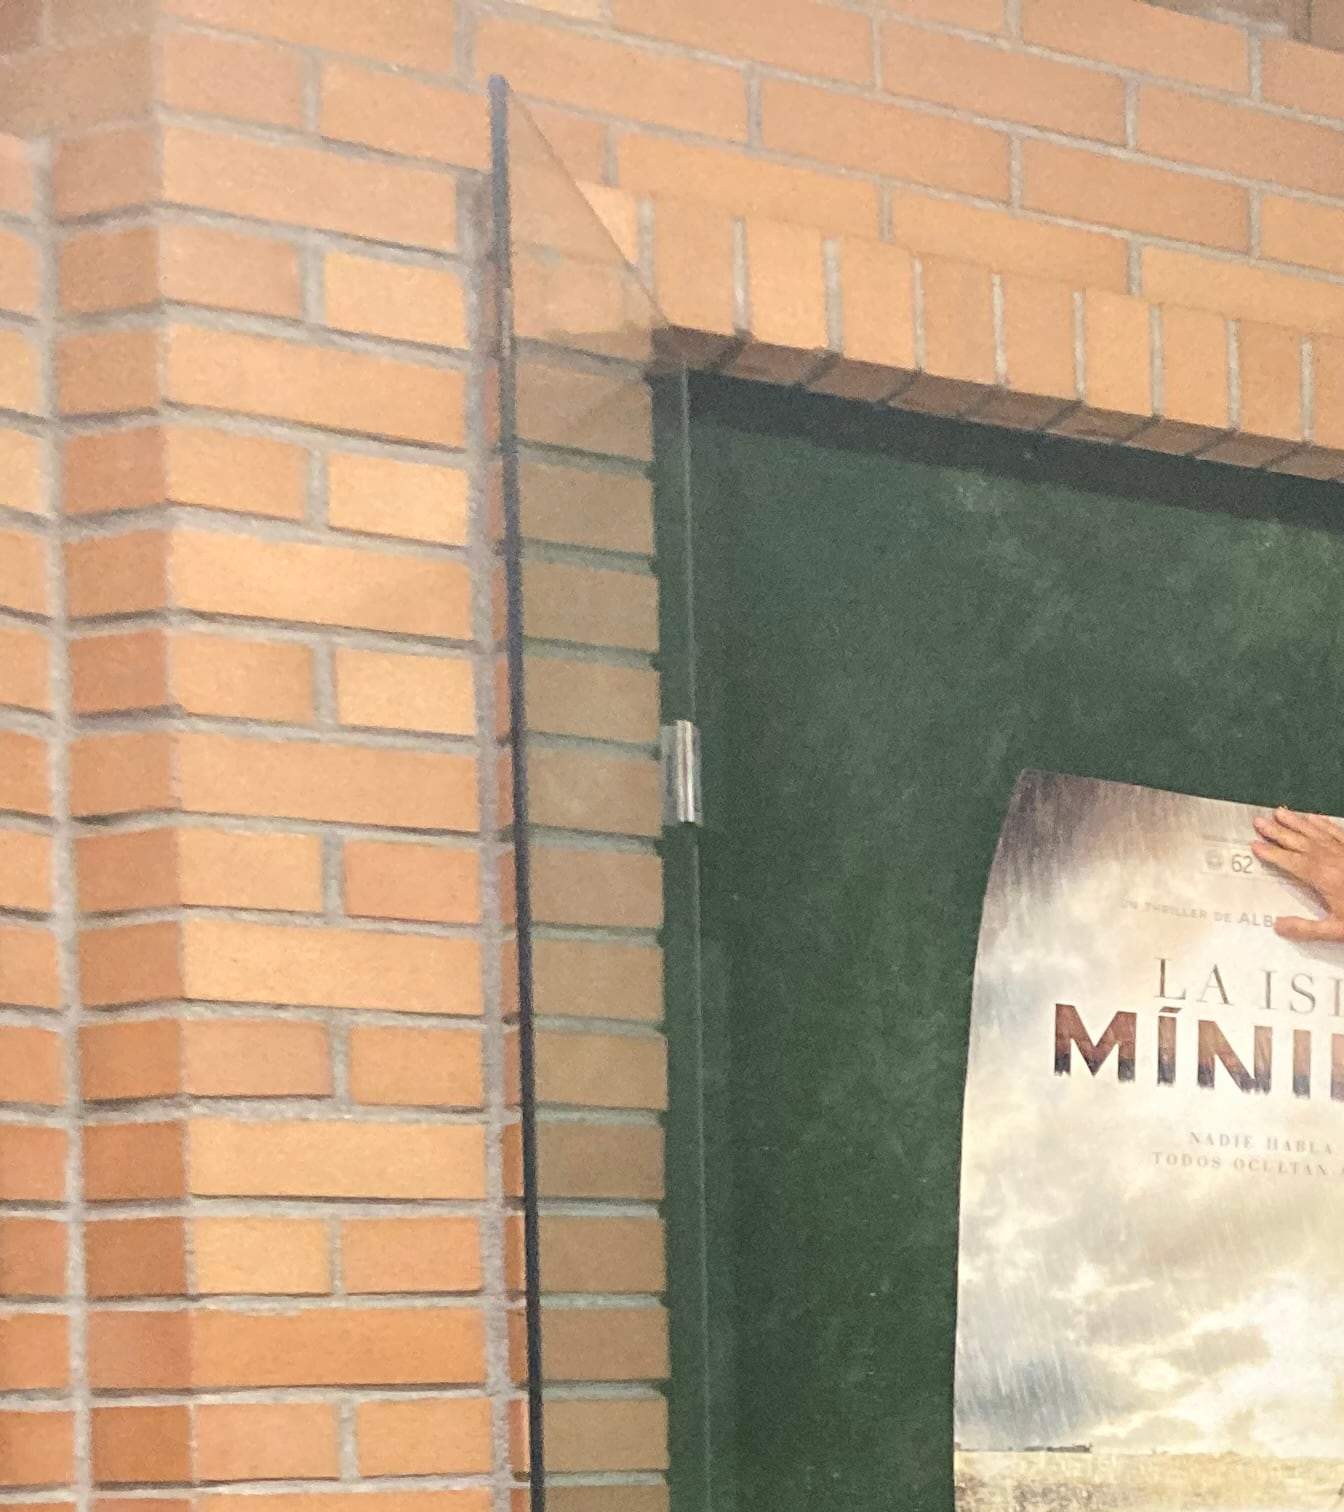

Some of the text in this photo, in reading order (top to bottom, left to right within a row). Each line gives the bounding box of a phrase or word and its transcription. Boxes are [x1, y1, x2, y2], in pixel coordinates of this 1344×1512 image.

[1231, 853, 1253, 874] 62
[1144, 901, 1207, 919] THRILLER
[1214, 911, 1232, 923] DE
[1237, 911, 1274, 928] ALB
[1154, 957, 1234, 1005] LA
[1189, 1131, 1334, 1154] NADIE HABLA
[1151, 1151, 1222, 1169] TODOS
[1233, 1157, 1329, 1177] OCULTAN
